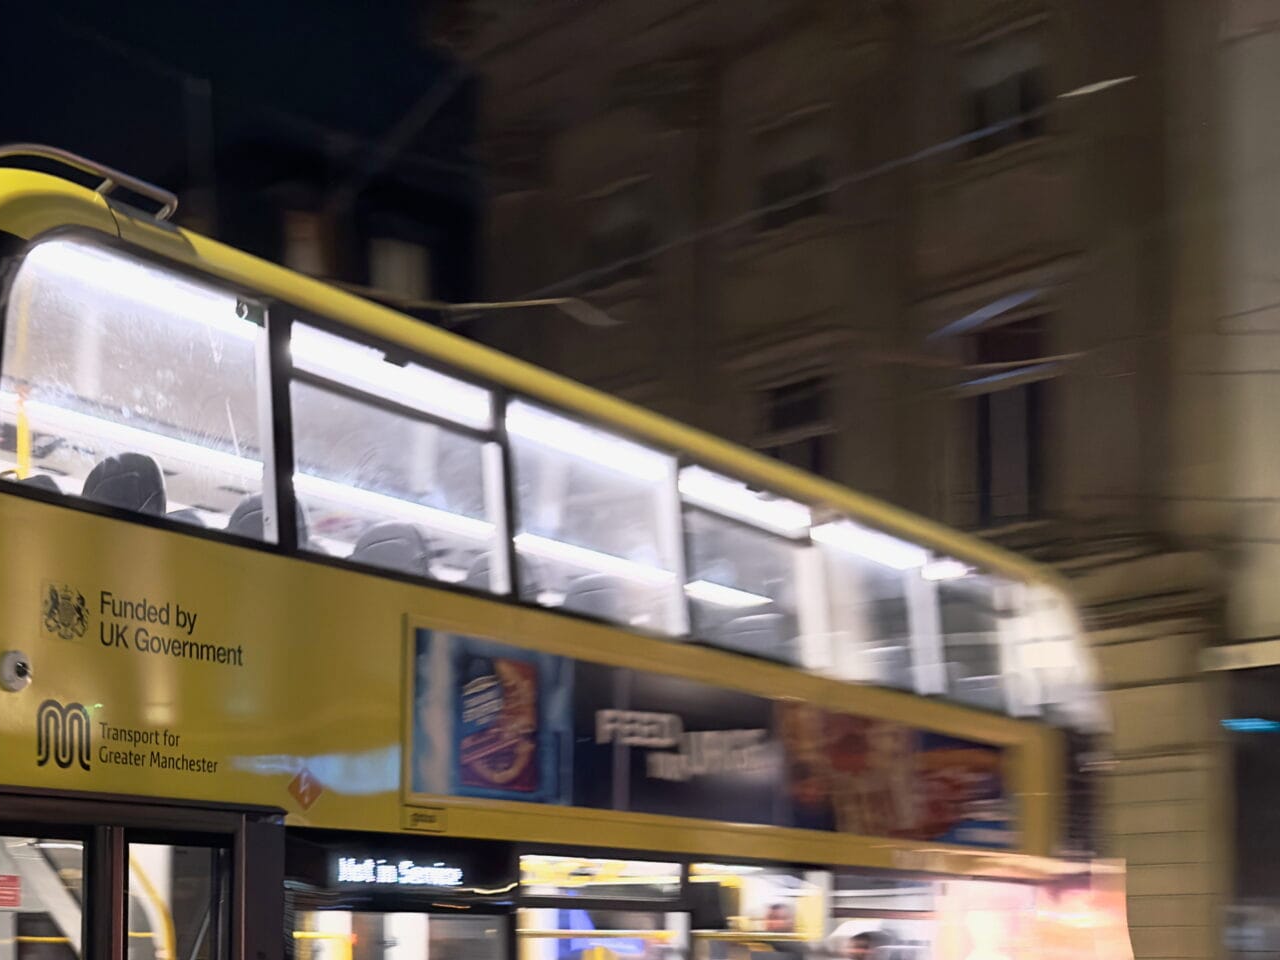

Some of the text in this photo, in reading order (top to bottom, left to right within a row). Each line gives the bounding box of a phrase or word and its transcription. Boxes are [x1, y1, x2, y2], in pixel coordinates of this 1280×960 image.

[99, 590, 197, 635] Funded by
[99, 621, 243, 667] UK Government
[99, 721, 180, 748] Transport for
[98, 745, 218, 774] Greater Manchester
[376, 860, 398, 883] in
[398, 861, 463, 886] Service
